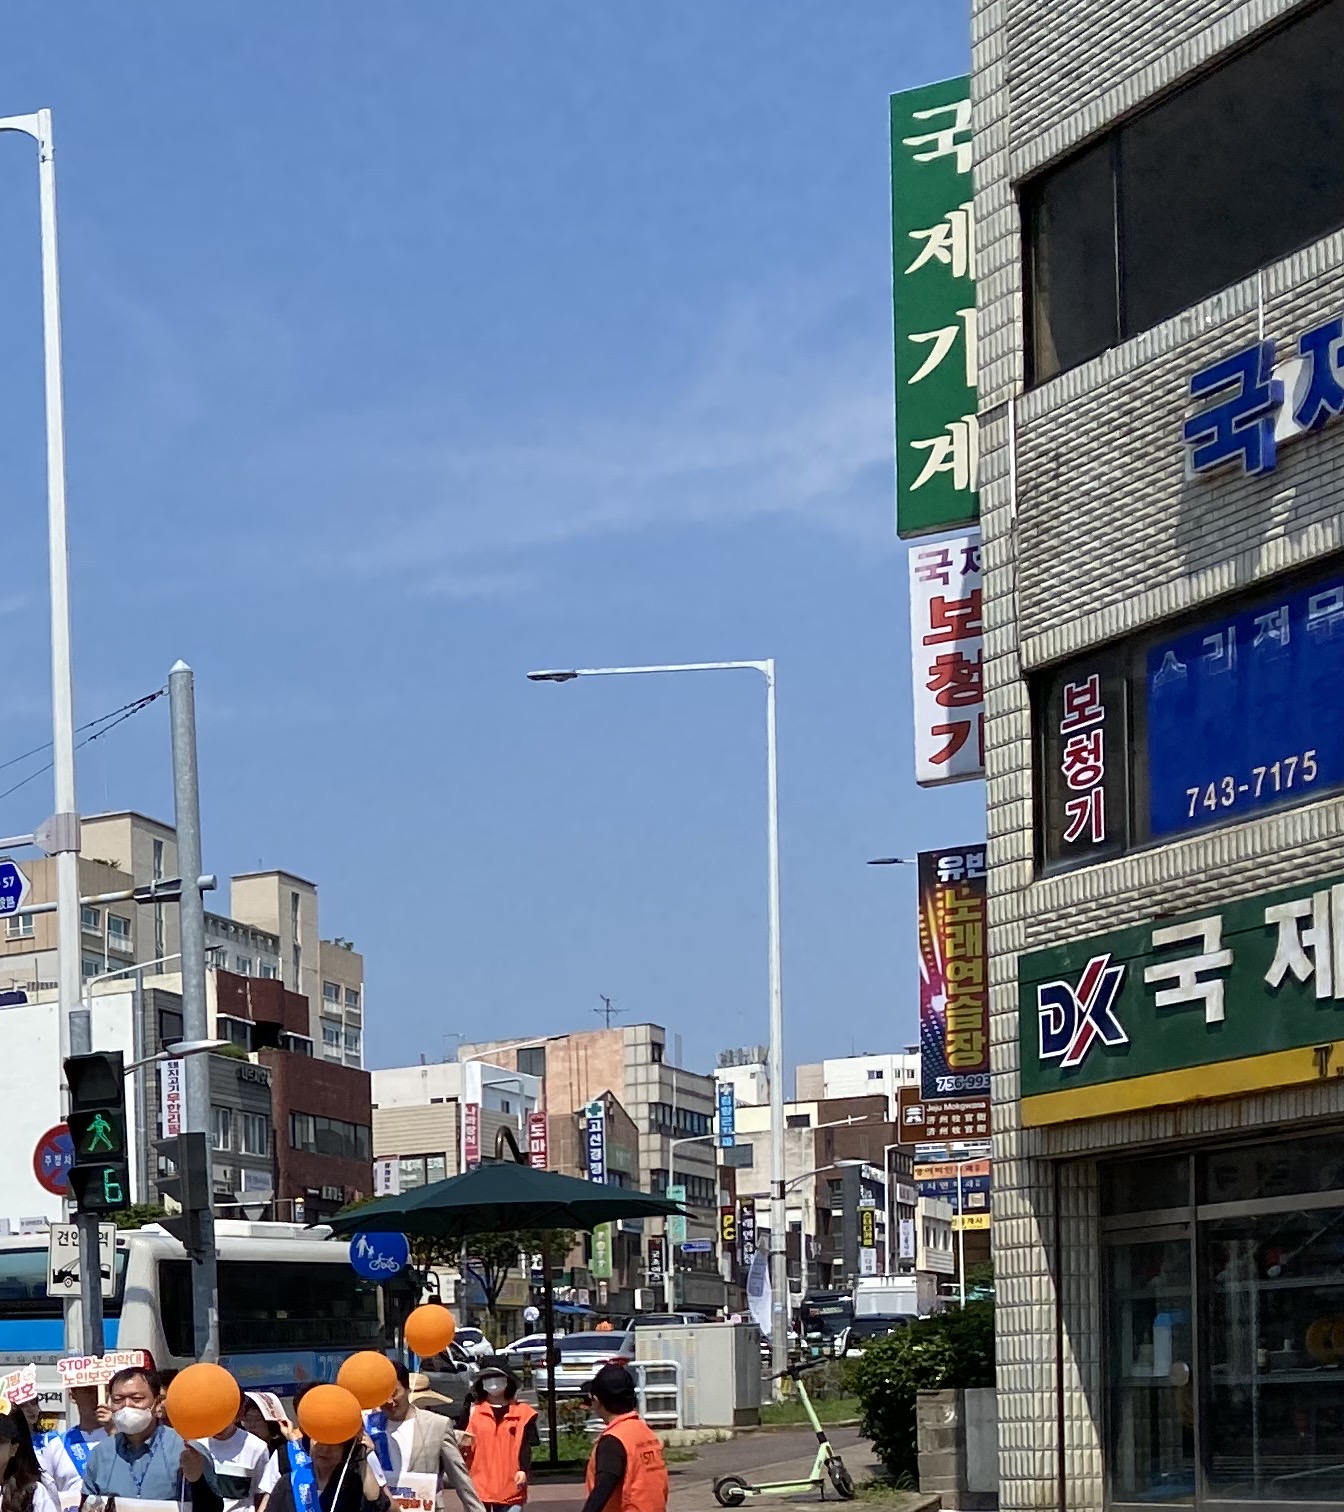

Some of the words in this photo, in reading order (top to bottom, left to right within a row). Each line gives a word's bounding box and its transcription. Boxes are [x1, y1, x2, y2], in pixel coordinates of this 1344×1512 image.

[902, 98, 979, 493] 국제기계
[1060, 673, 1105, 842] 보청기
[1186, 749, 1318, 818] 743-7175
[945, 890, 987, 1068] 노래연습장
[57, 1231, 109, 1247] 견인역
